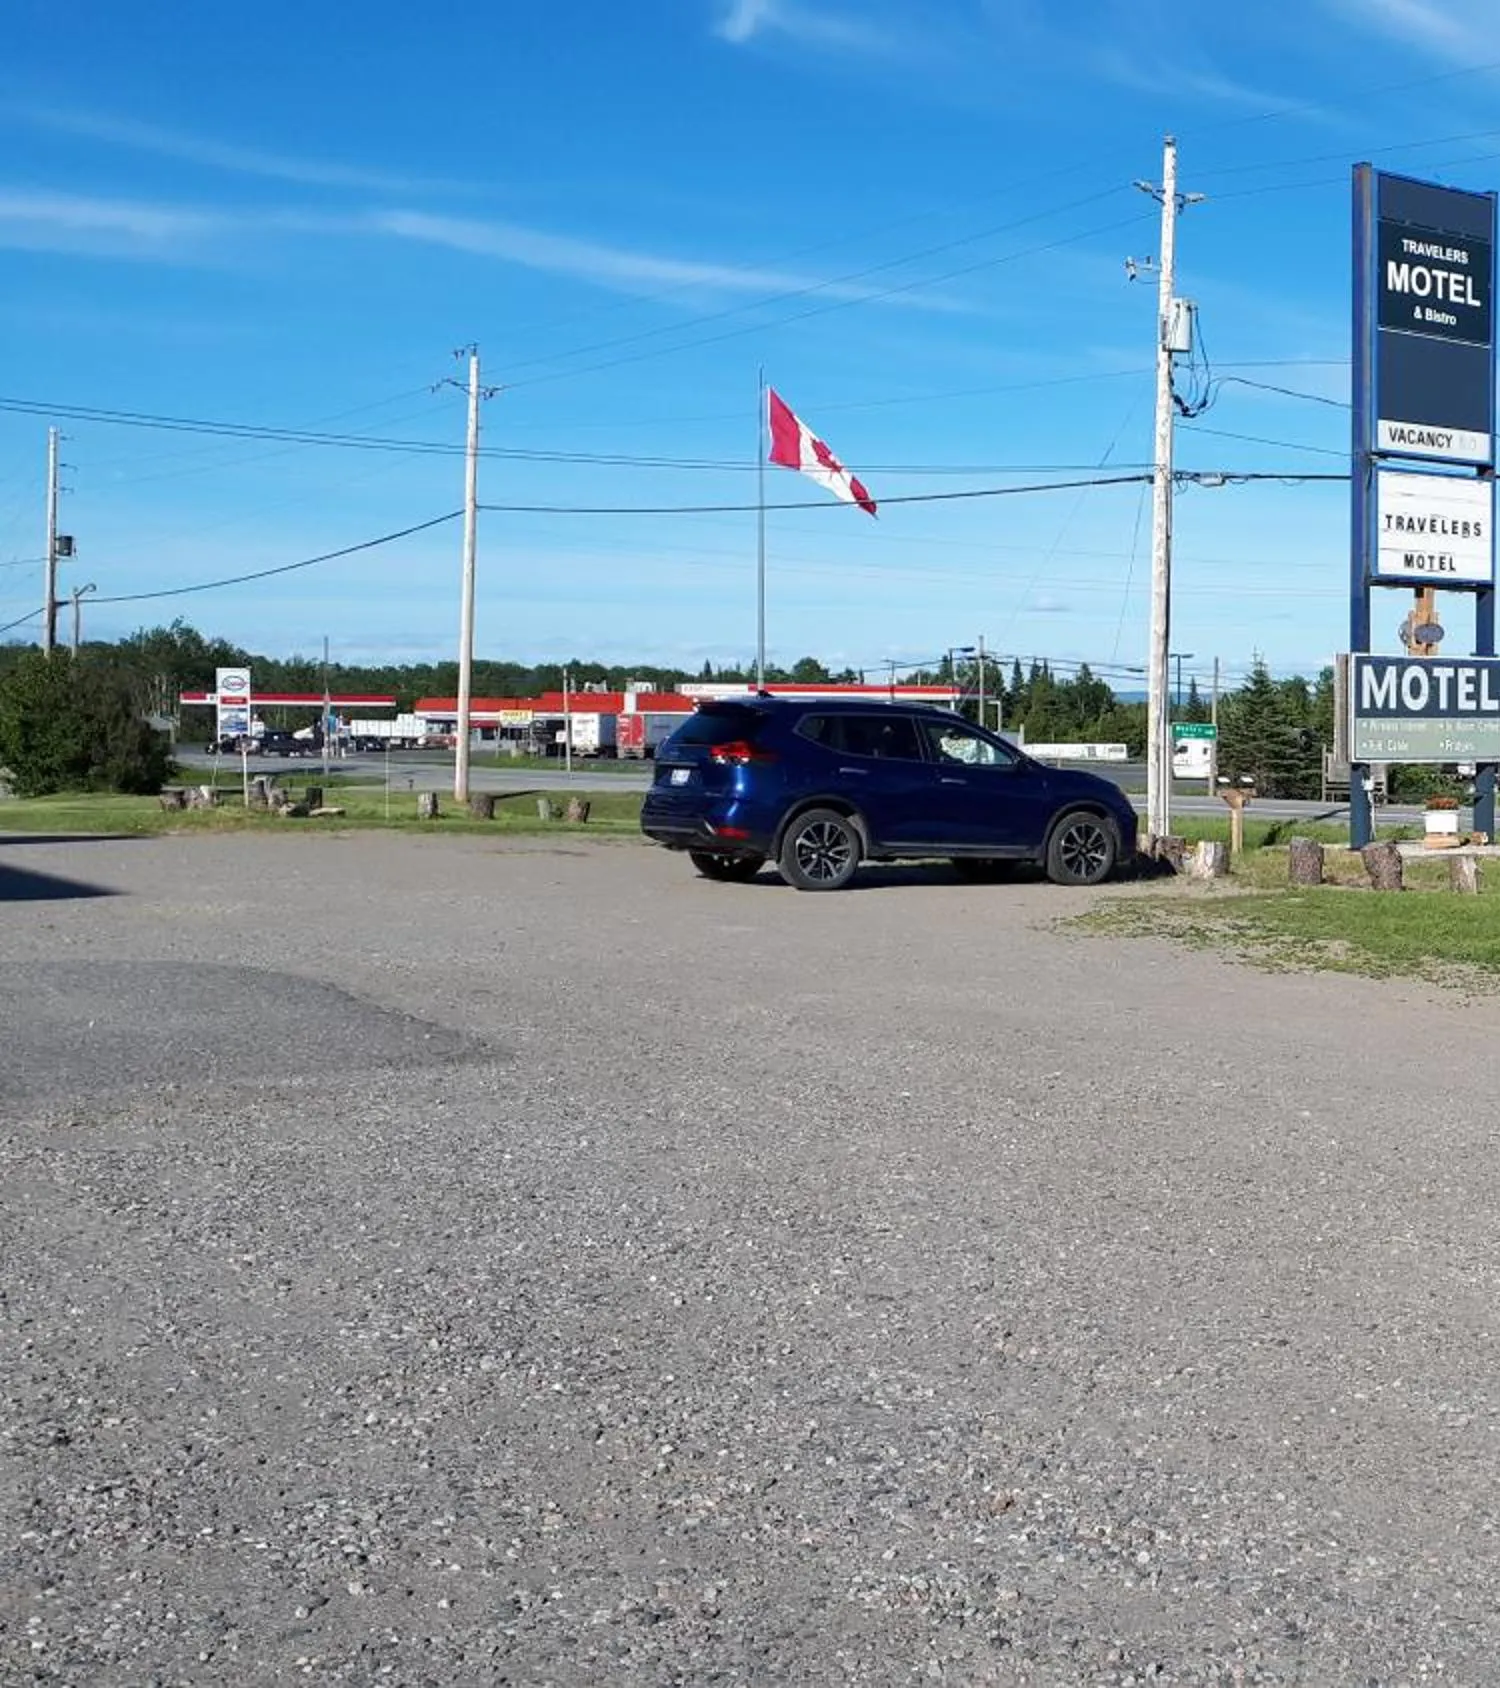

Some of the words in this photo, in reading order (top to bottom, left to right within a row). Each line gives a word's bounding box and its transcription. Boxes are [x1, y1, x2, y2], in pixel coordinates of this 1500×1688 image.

[1402, 238, 1469, 264] TRAVELERS
[1387, 260, 1481, 307] MOTEL
[1413, 305, 1423, 319] &
[1425, 307, 1457, 325] Bistro
[1388, 426, 1453, 448] VACANCY
[1385, 514, 1482, 538] TRAVELERS
[1403, 553, 1457, 572] MOTEL
[1361, 665, 1499, 711] MOTEL
